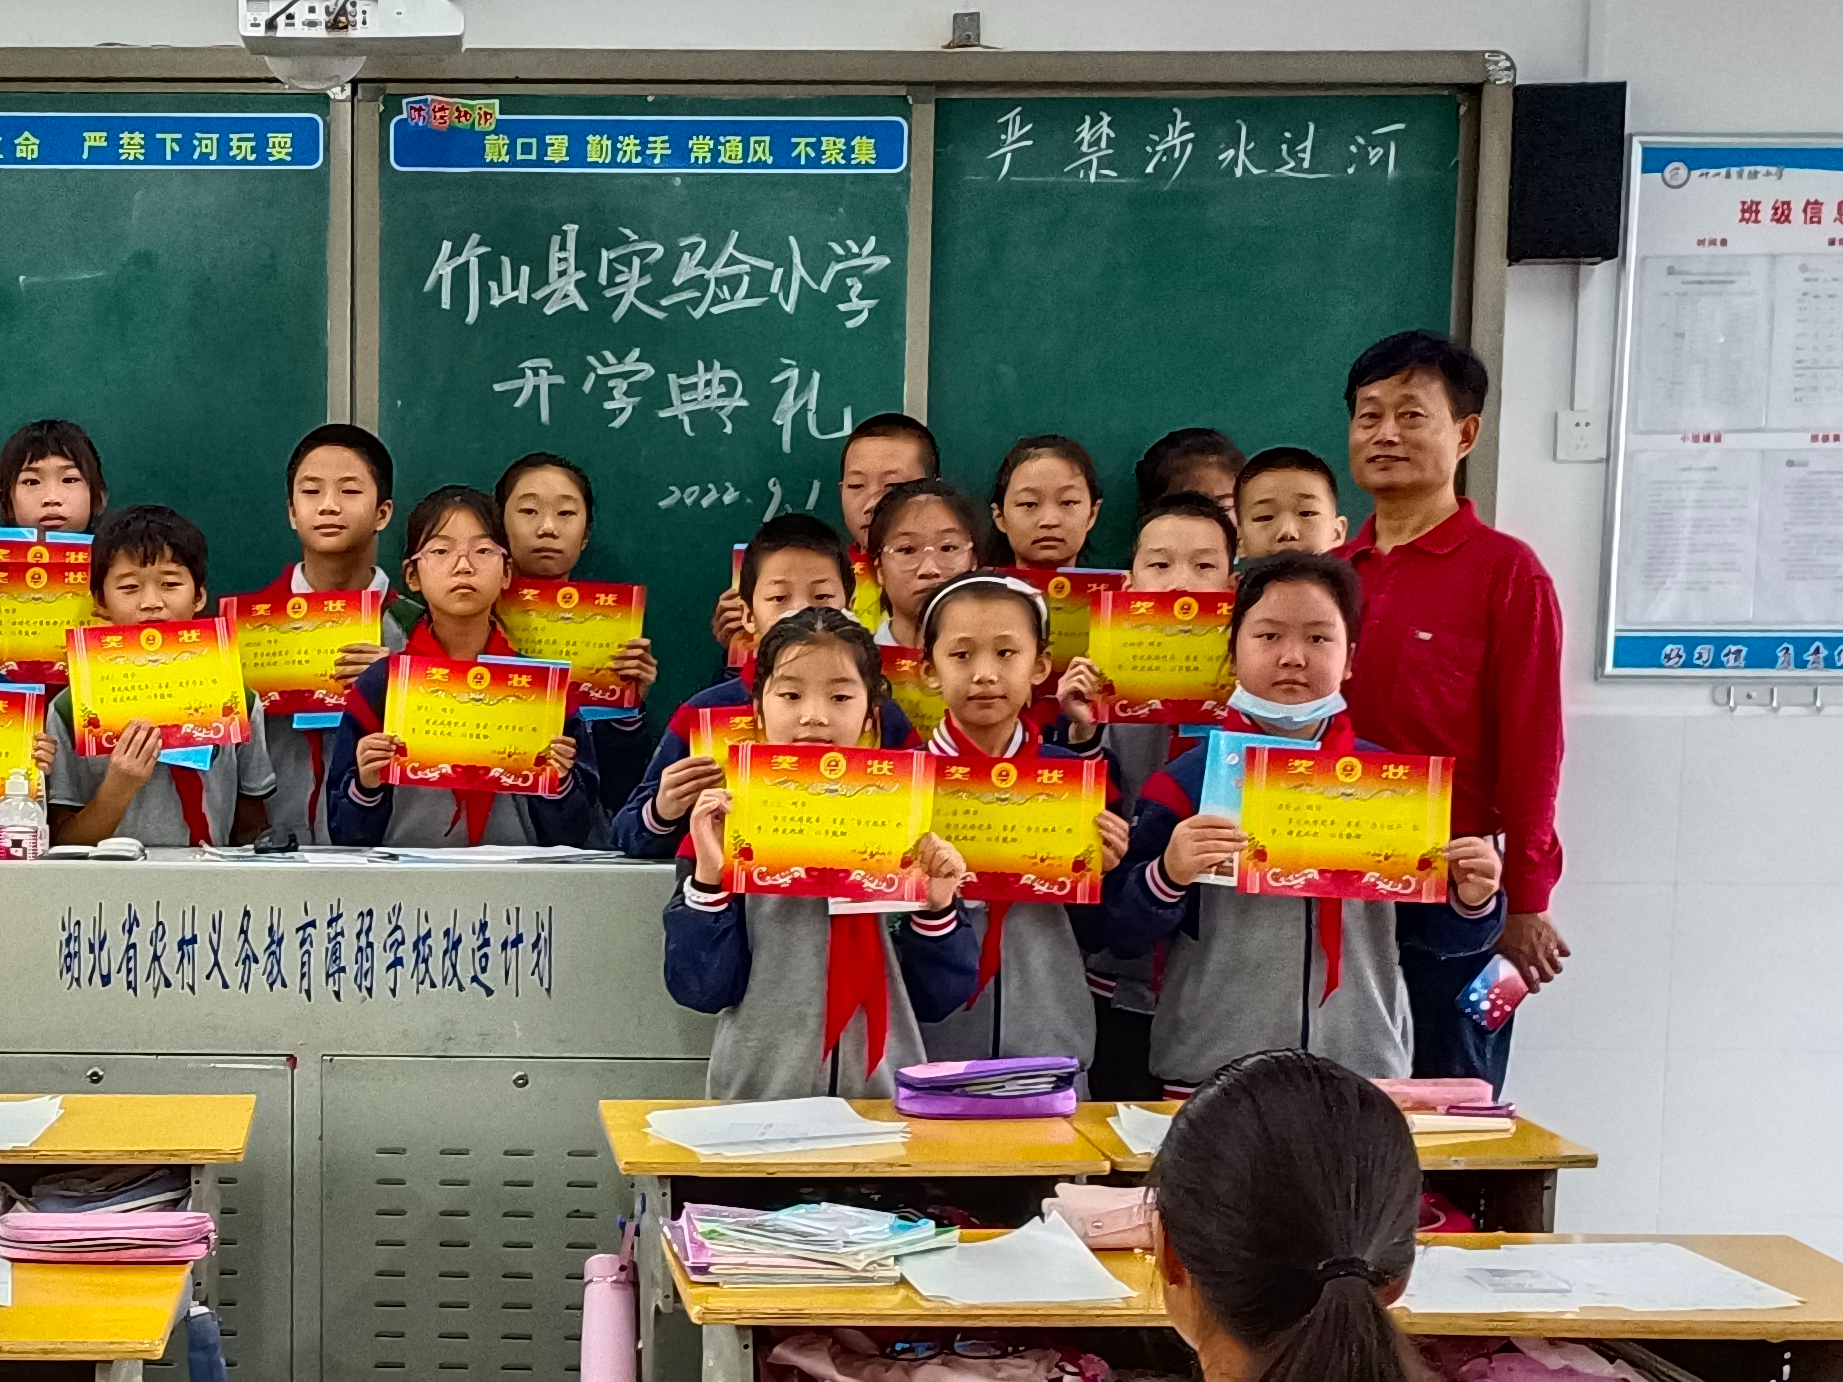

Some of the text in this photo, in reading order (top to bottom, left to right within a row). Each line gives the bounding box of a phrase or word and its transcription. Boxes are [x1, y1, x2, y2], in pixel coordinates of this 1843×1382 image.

[82, 131, 294, 163] 严禁下河玩耍
[484, 134, 878, 166] 戴口罩 勤洗手 常通风 不聚集
[986, 106, 1406, 190] 严禁涉水过河
[422, 223, 891, 328] 竹山县实验小学
[493, 348, 853, 454] 开学典礼
[58, 898, 554, 1002] 湖北省农村义务教育薄弱学校改造计划
